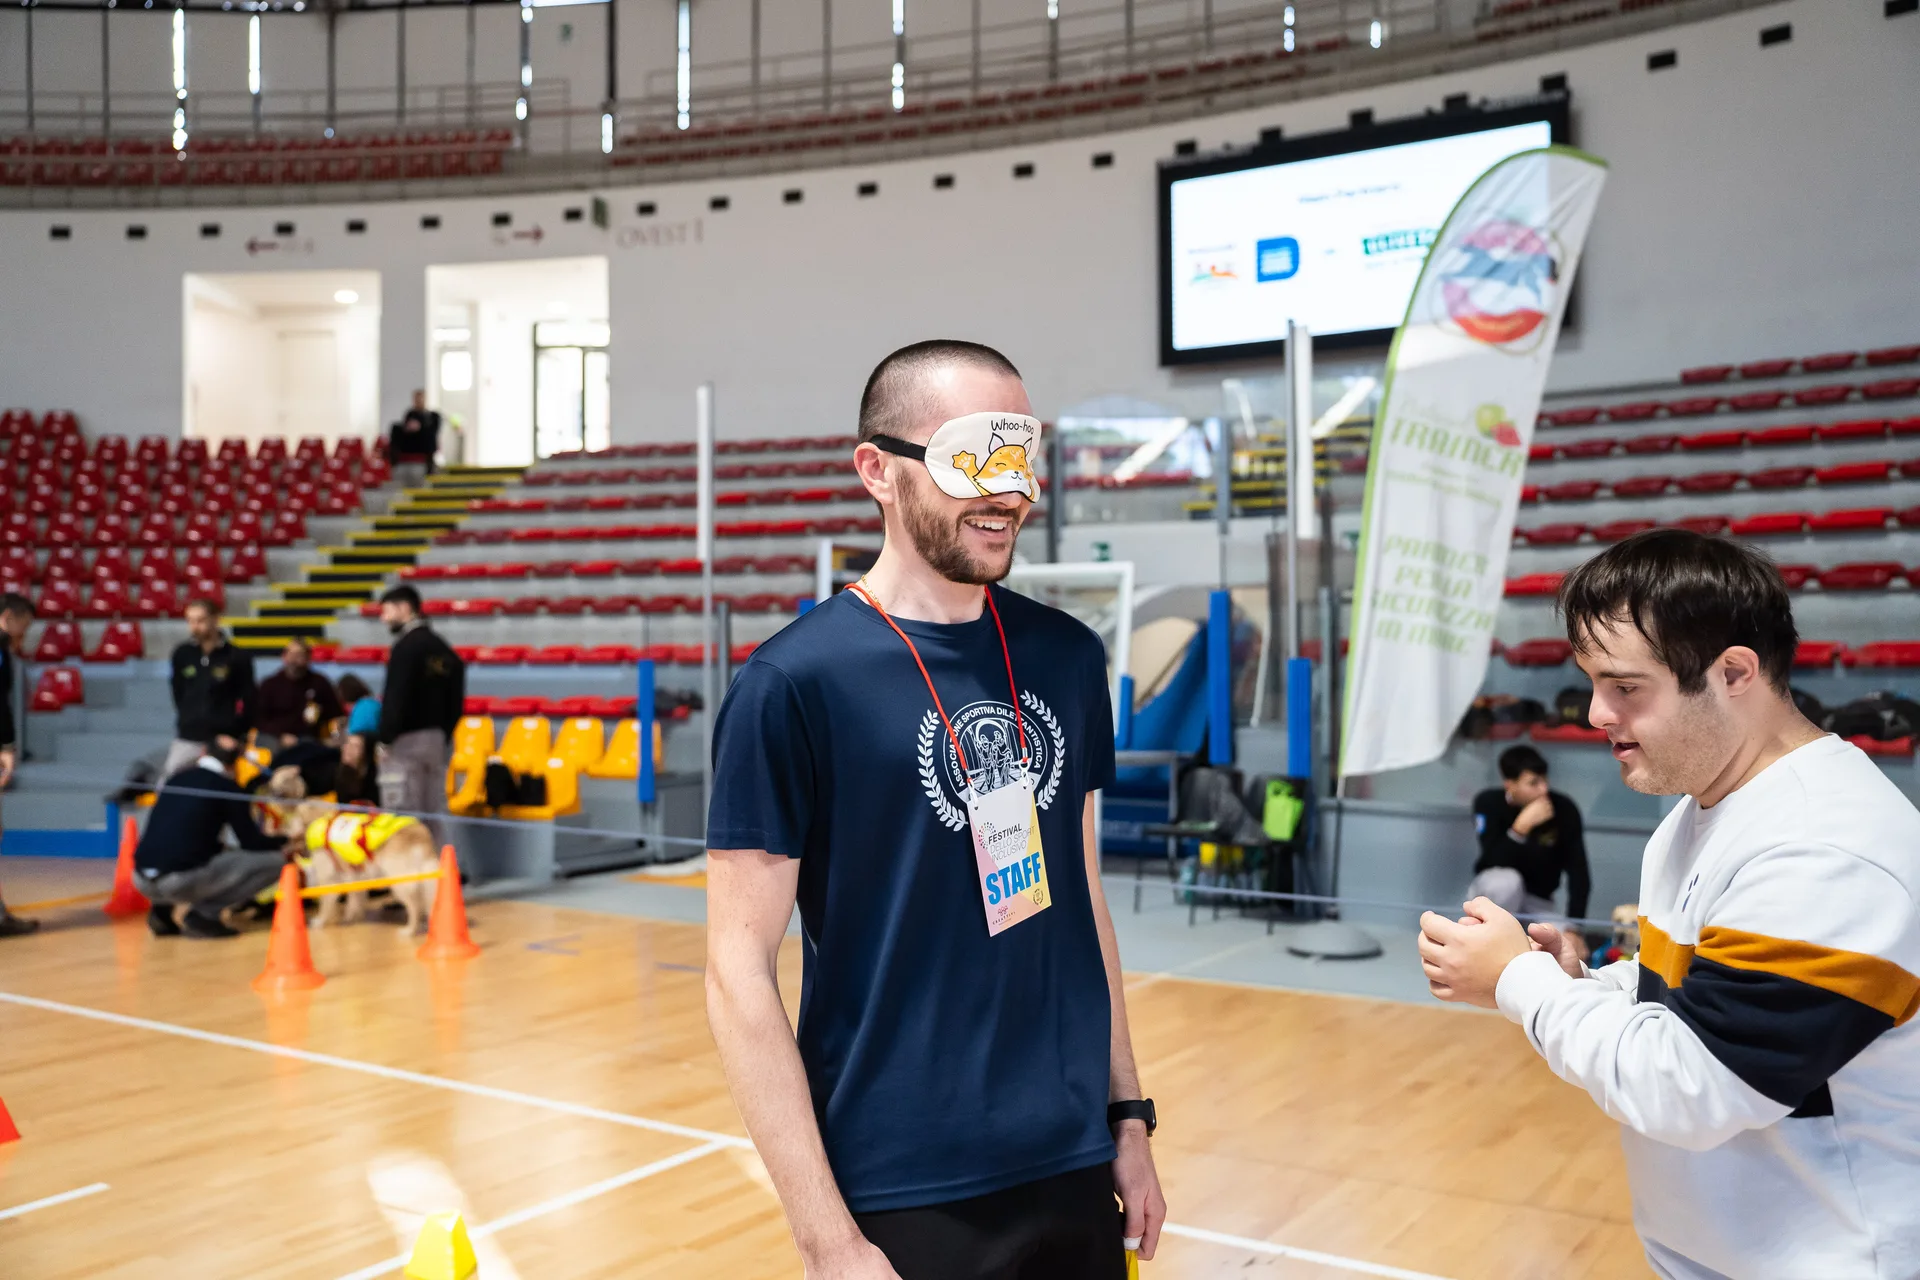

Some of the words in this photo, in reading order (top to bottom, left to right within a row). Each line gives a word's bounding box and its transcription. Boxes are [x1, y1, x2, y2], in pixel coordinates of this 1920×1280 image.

[991, 418, 1034, 434] Whoo-hoo
[949, 721, 966, 787] ASSOCIAONE
[961, 706, 996, 721] SPORTIVA
[988, 823, 1022, 845] FESTIVAL
[990, 837, 1013, 854] DELLO
[1014, 826, 1035, 843] SPORT
[992, 840, 1027, 862] INCLUSIVO
[985, 852, 1041, 905] STAFF
